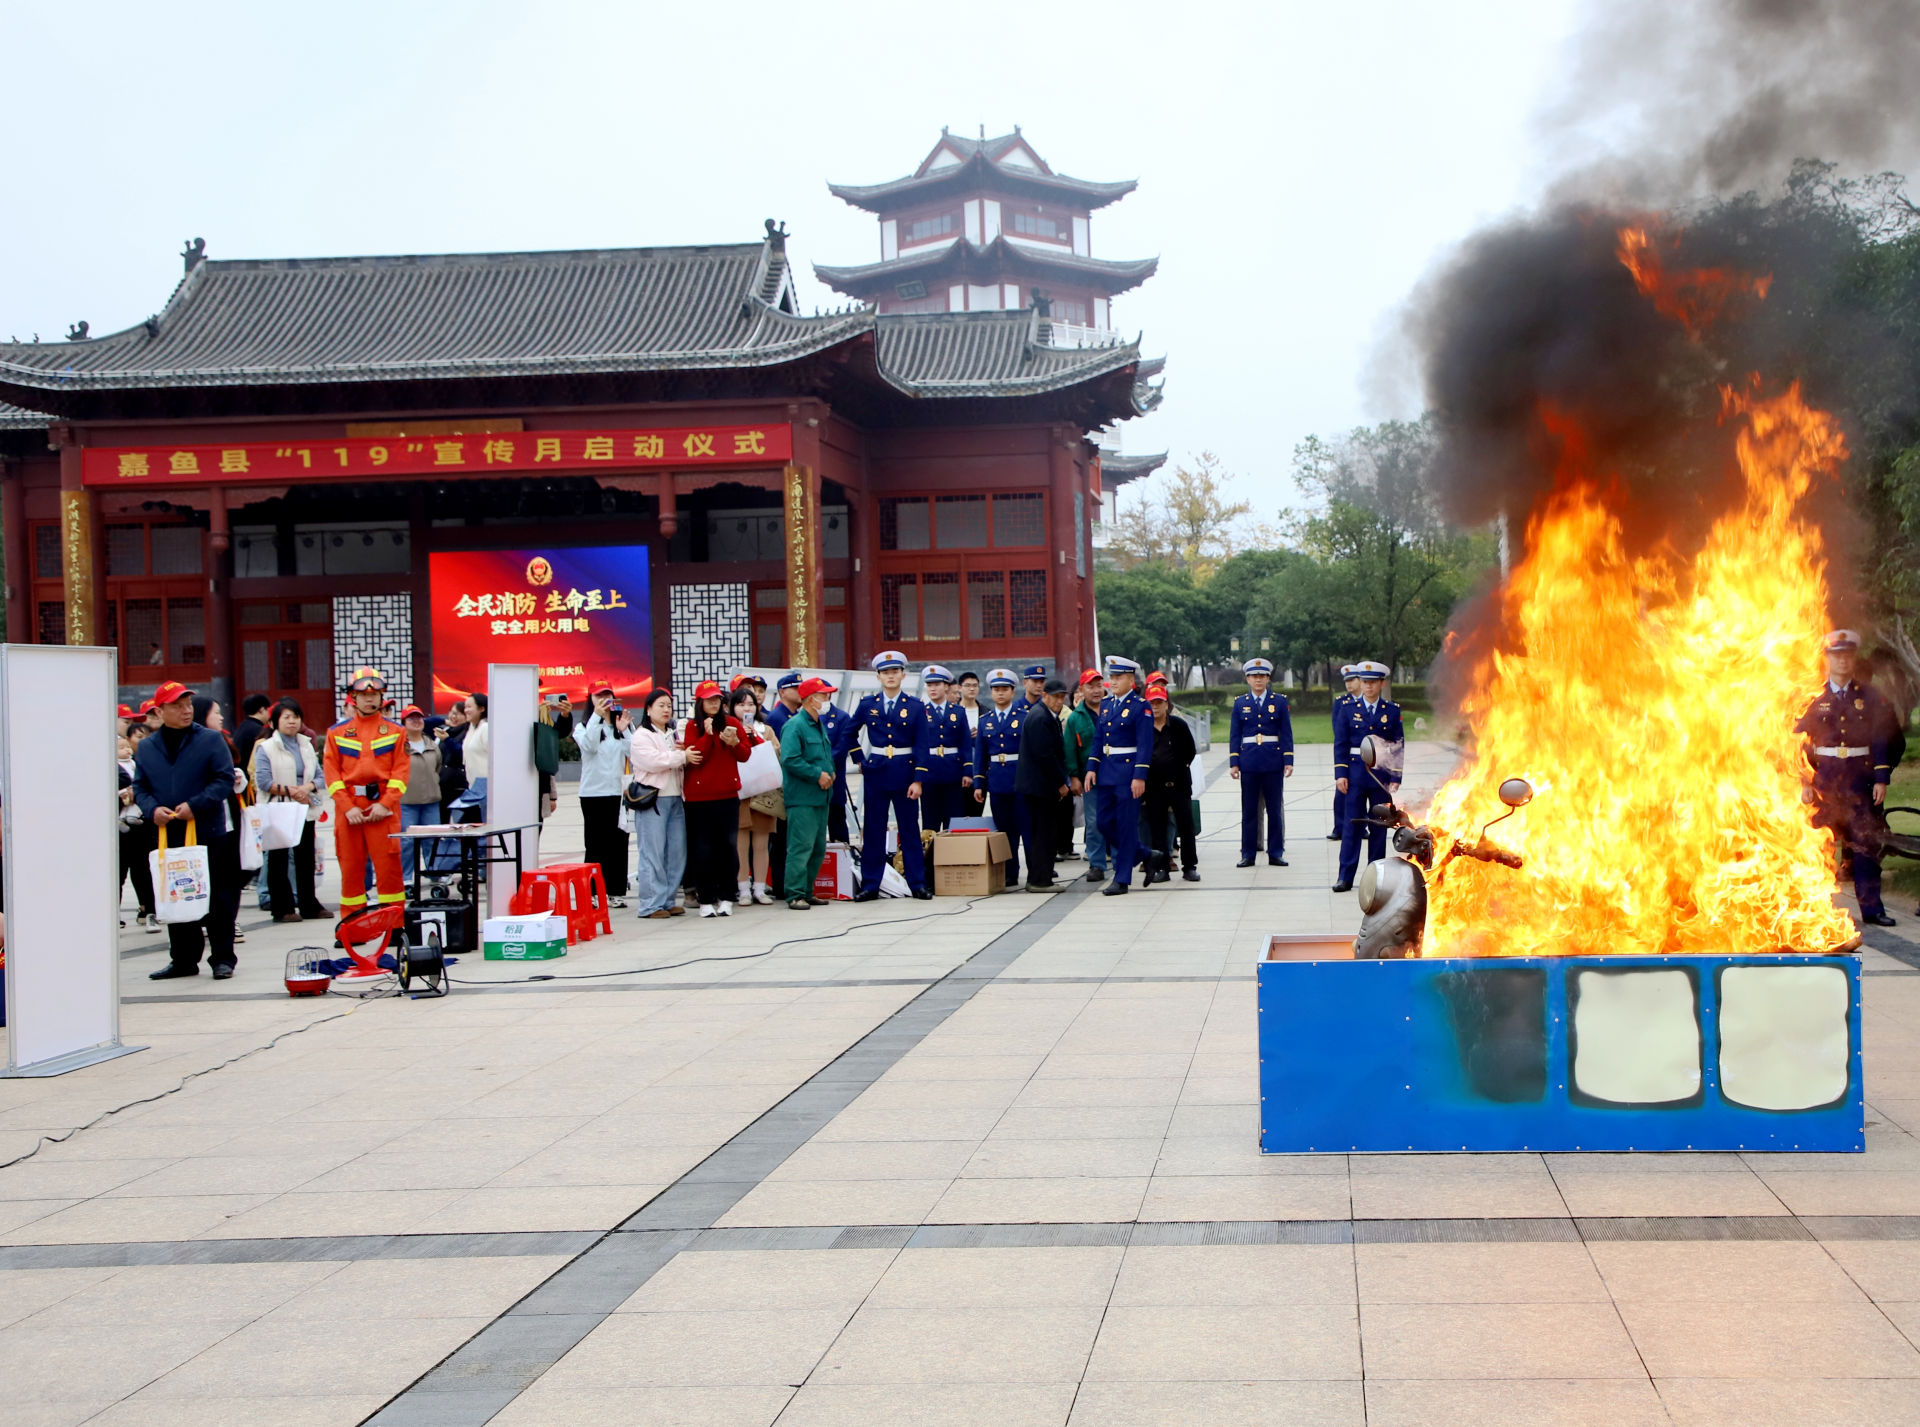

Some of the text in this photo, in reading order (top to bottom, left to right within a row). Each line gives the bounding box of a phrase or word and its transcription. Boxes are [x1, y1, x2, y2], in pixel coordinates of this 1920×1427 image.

[452, 588, 627, 618] 全民消防 生命至上
[491, 617, 590, 635] 安全用火用电
